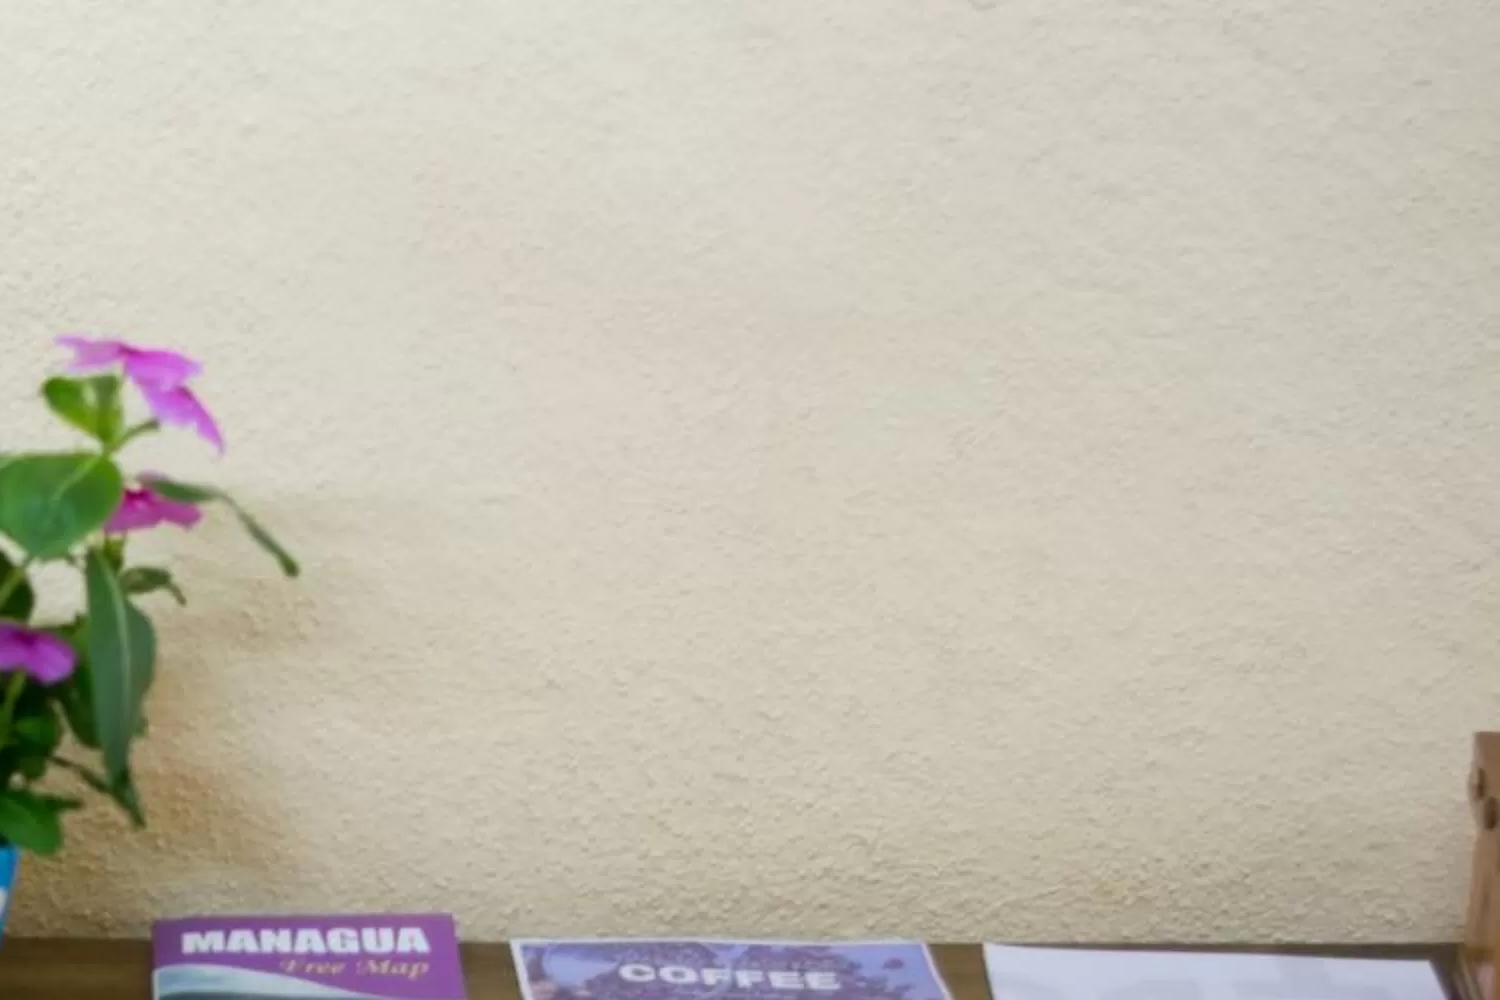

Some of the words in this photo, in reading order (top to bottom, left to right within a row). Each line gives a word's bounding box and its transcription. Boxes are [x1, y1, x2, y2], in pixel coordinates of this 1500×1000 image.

[180, 926, 431, 955] MANAGUA
[280, 958, 347, 976] Free
[356, 957, 431, 980] Map
[618, 963, 842, 990] COFFEE
